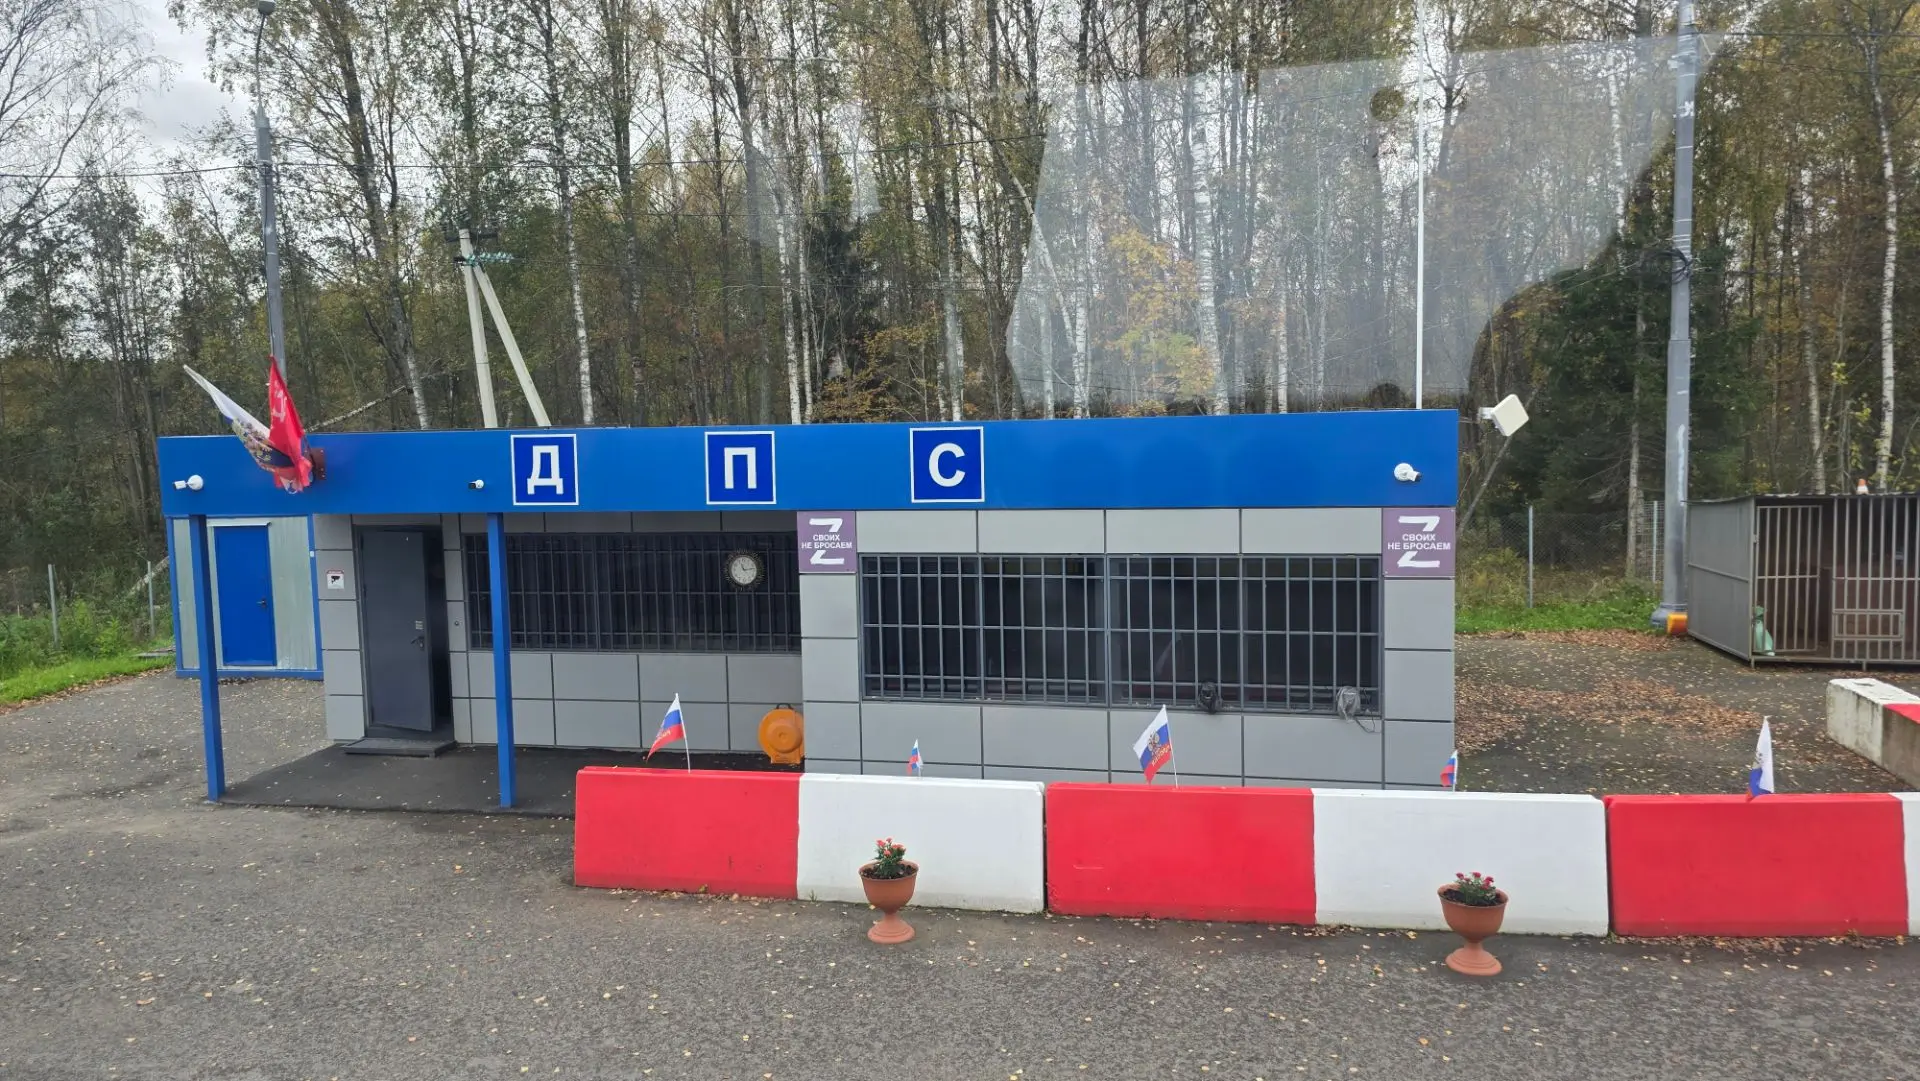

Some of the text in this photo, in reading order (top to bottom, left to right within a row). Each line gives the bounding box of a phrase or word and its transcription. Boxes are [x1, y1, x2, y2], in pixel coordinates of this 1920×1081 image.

[527, 442, 966, 494] Д П С
[1402, 533, 1436, 542] СВОИХ
[814, 541, 853, 549] БРОСАЕМ
[1387, 542, 1452, 550] НЕ БРОСАЕМ
